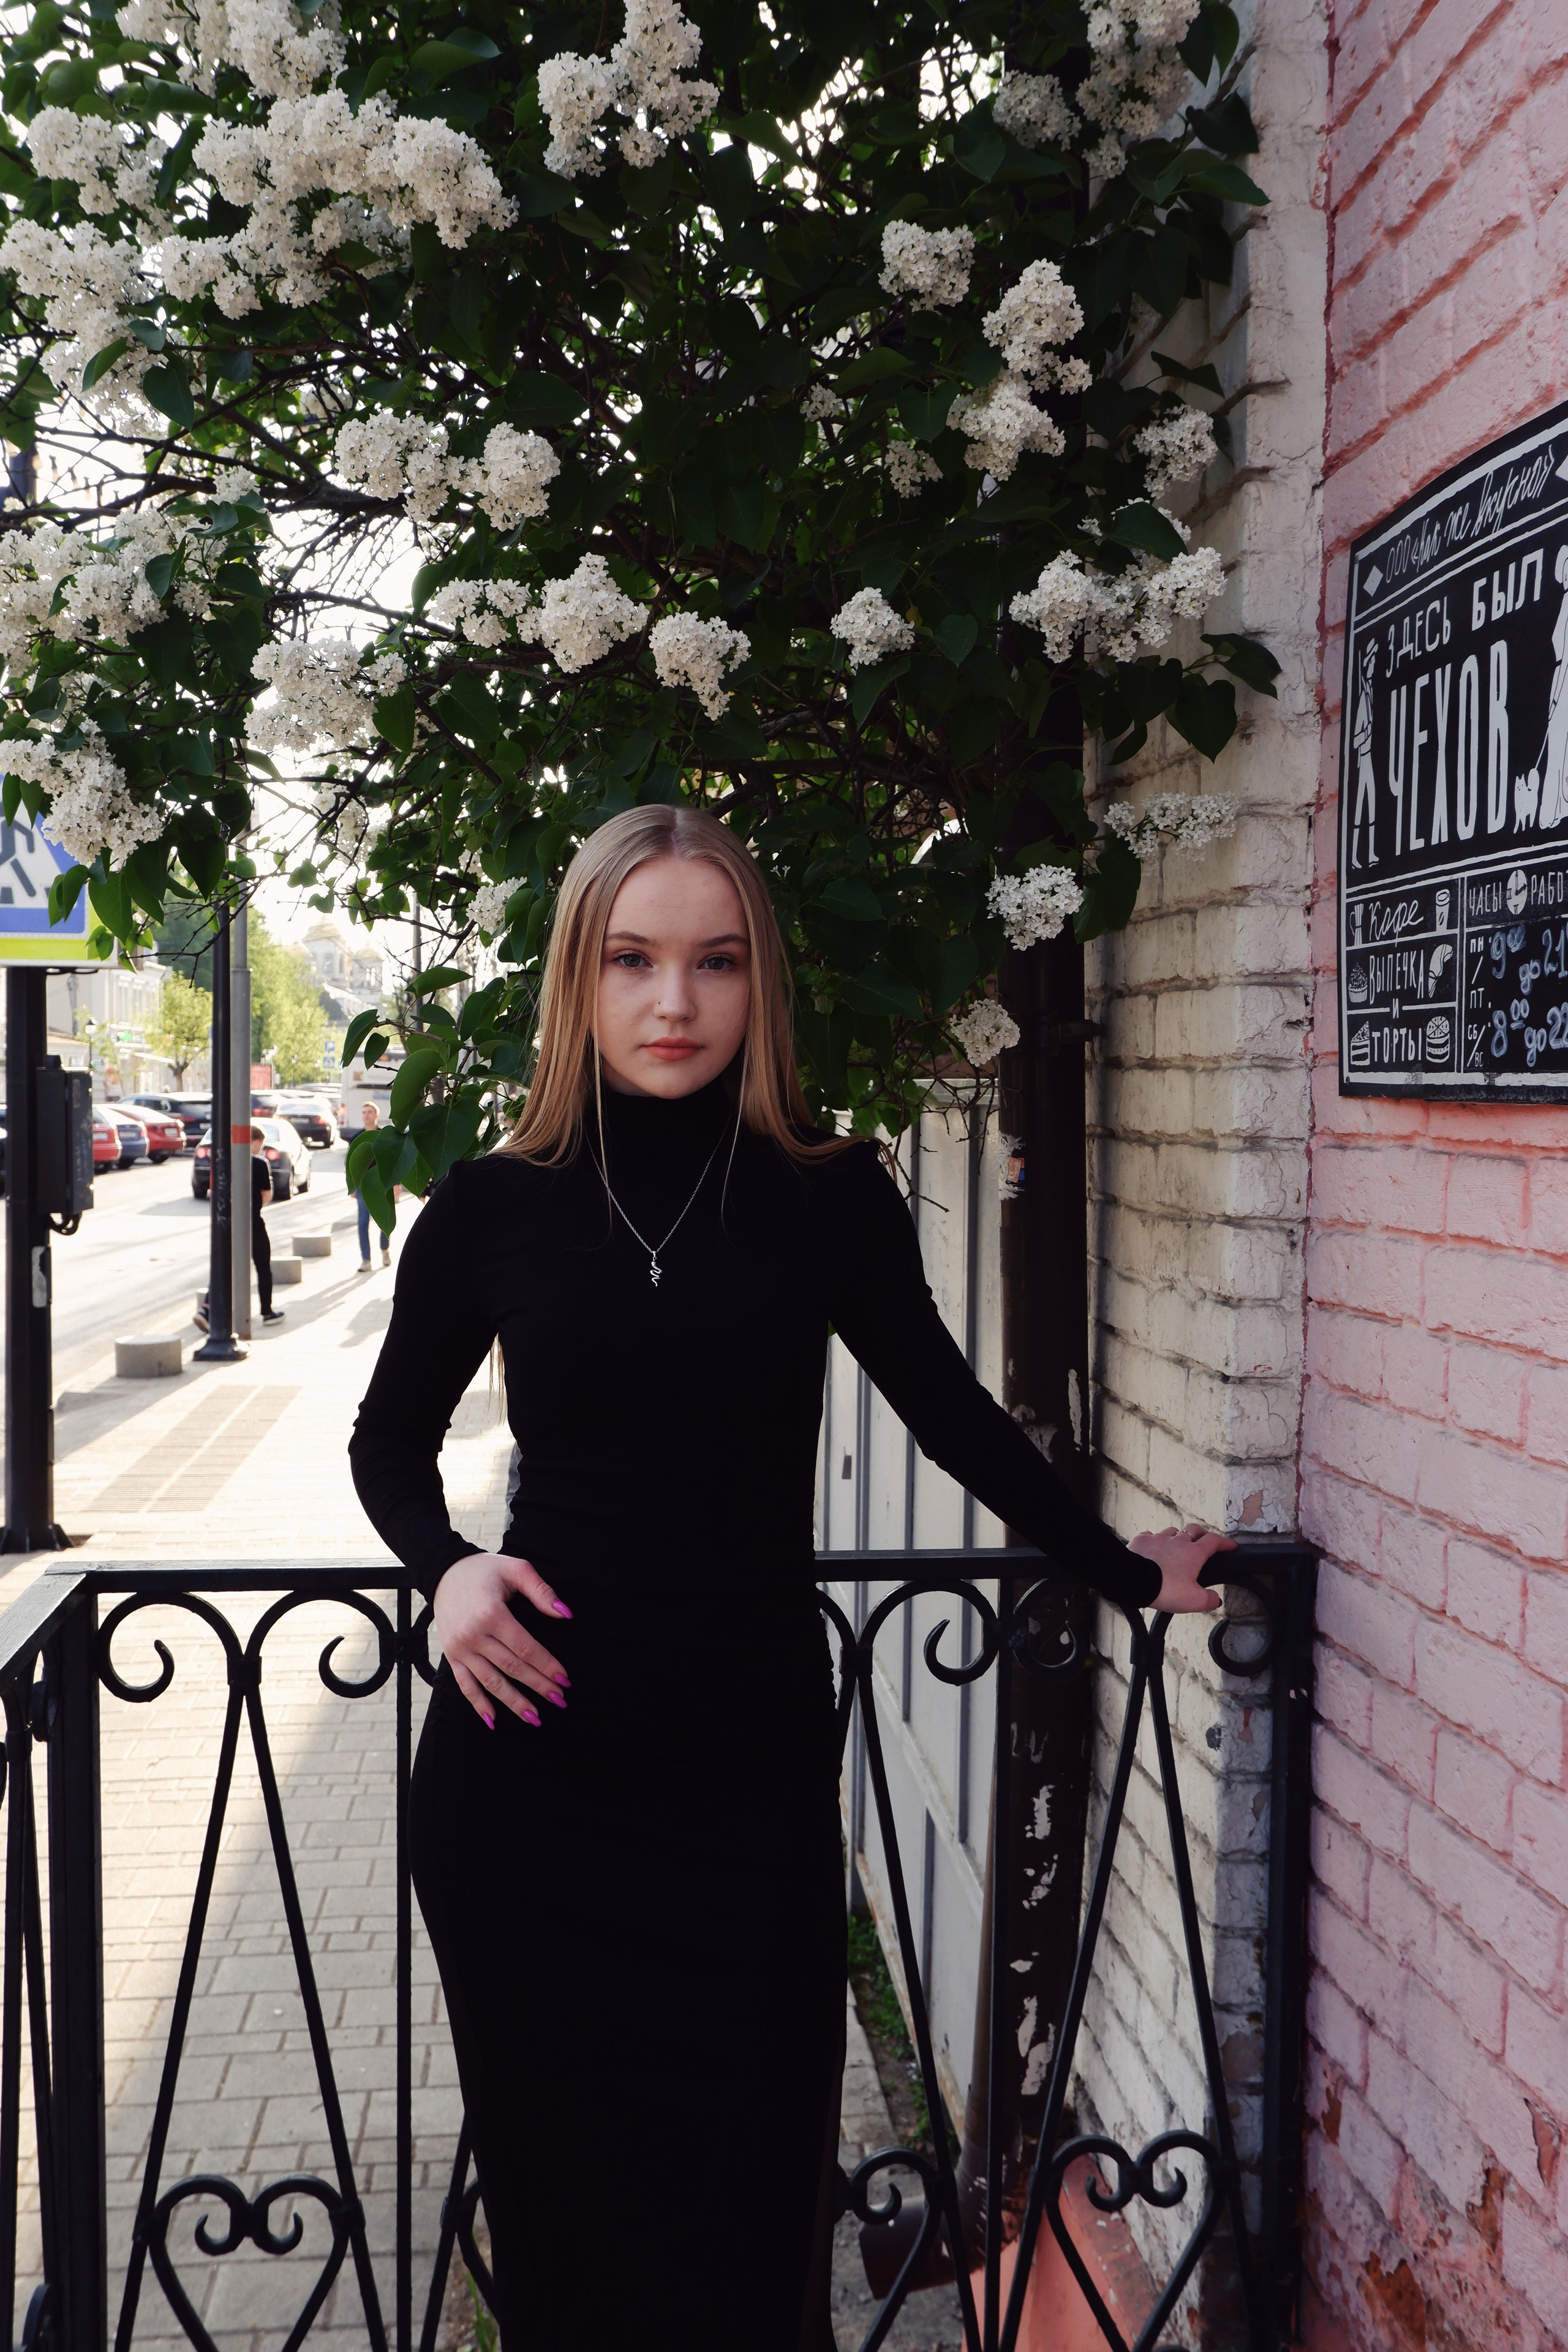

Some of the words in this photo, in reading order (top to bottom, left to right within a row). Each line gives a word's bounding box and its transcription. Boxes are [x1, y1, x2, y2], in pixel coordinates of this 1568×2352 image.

[1386, 534, 1411, 583] ООО
[1444, 502, 1471, 547] же
[1386, 596, 1451, 678] ЗДЕСЬ
[1471, 548, 1543, 631] БЫЛ
[1389, 639, 1509, 856] ЧЕХОВ
[1469, 881, 1502, 916] ЧАСЫ
[1369, 900, 1424, 947] Кофе
[1542, 920, 1568, 979] 21
[1370, 949, 1424, 1005] ВЫПЕЧКА
[1392, 998, 1400, 1019] И
[1470, 987, 1484, 1009] ПТ
[1372, 1027, 1422, 1063] ТОРТЫ
[1468, 1023, 1477, 1040] СБ
[1474, 1052, 1483, 1067] ВС
